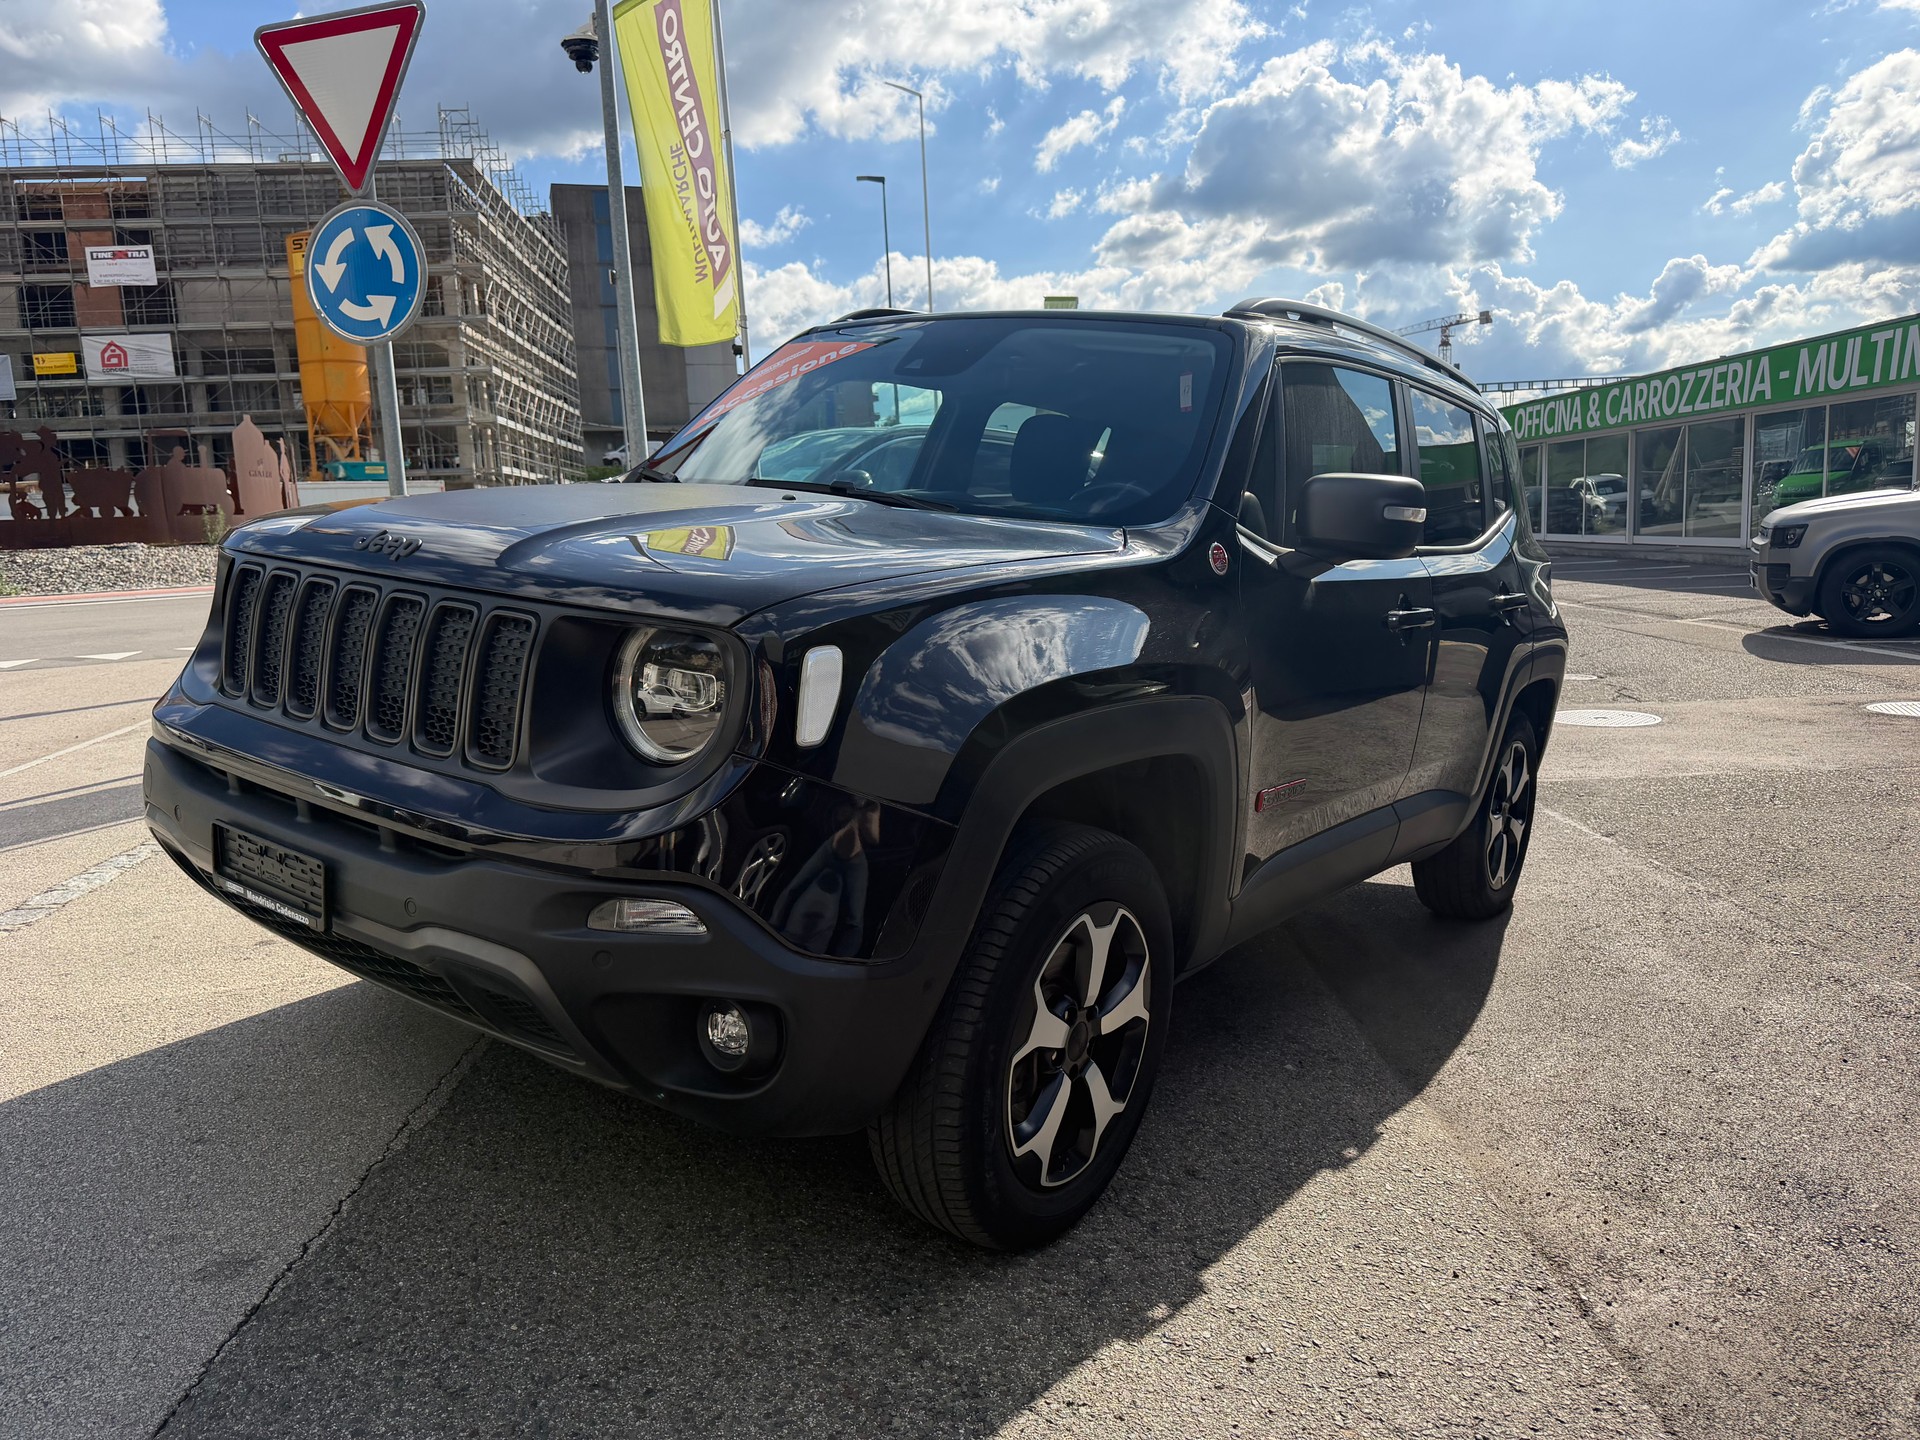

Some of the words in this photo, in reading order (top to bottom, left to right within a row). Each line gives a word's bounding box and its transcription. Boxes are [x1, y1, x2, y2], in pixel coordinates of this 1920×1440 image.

[1514, 396, 1582, 440] OFFICINA
[1586, 391, 1600, 428] &
[1605, 355, 1772, 425] CARROZZERIA
[353, 529, 423, 561] Jeep
[246, 889, 276, 910] Mendrisio
[276, 903, 310, 925] Cadenazzo
